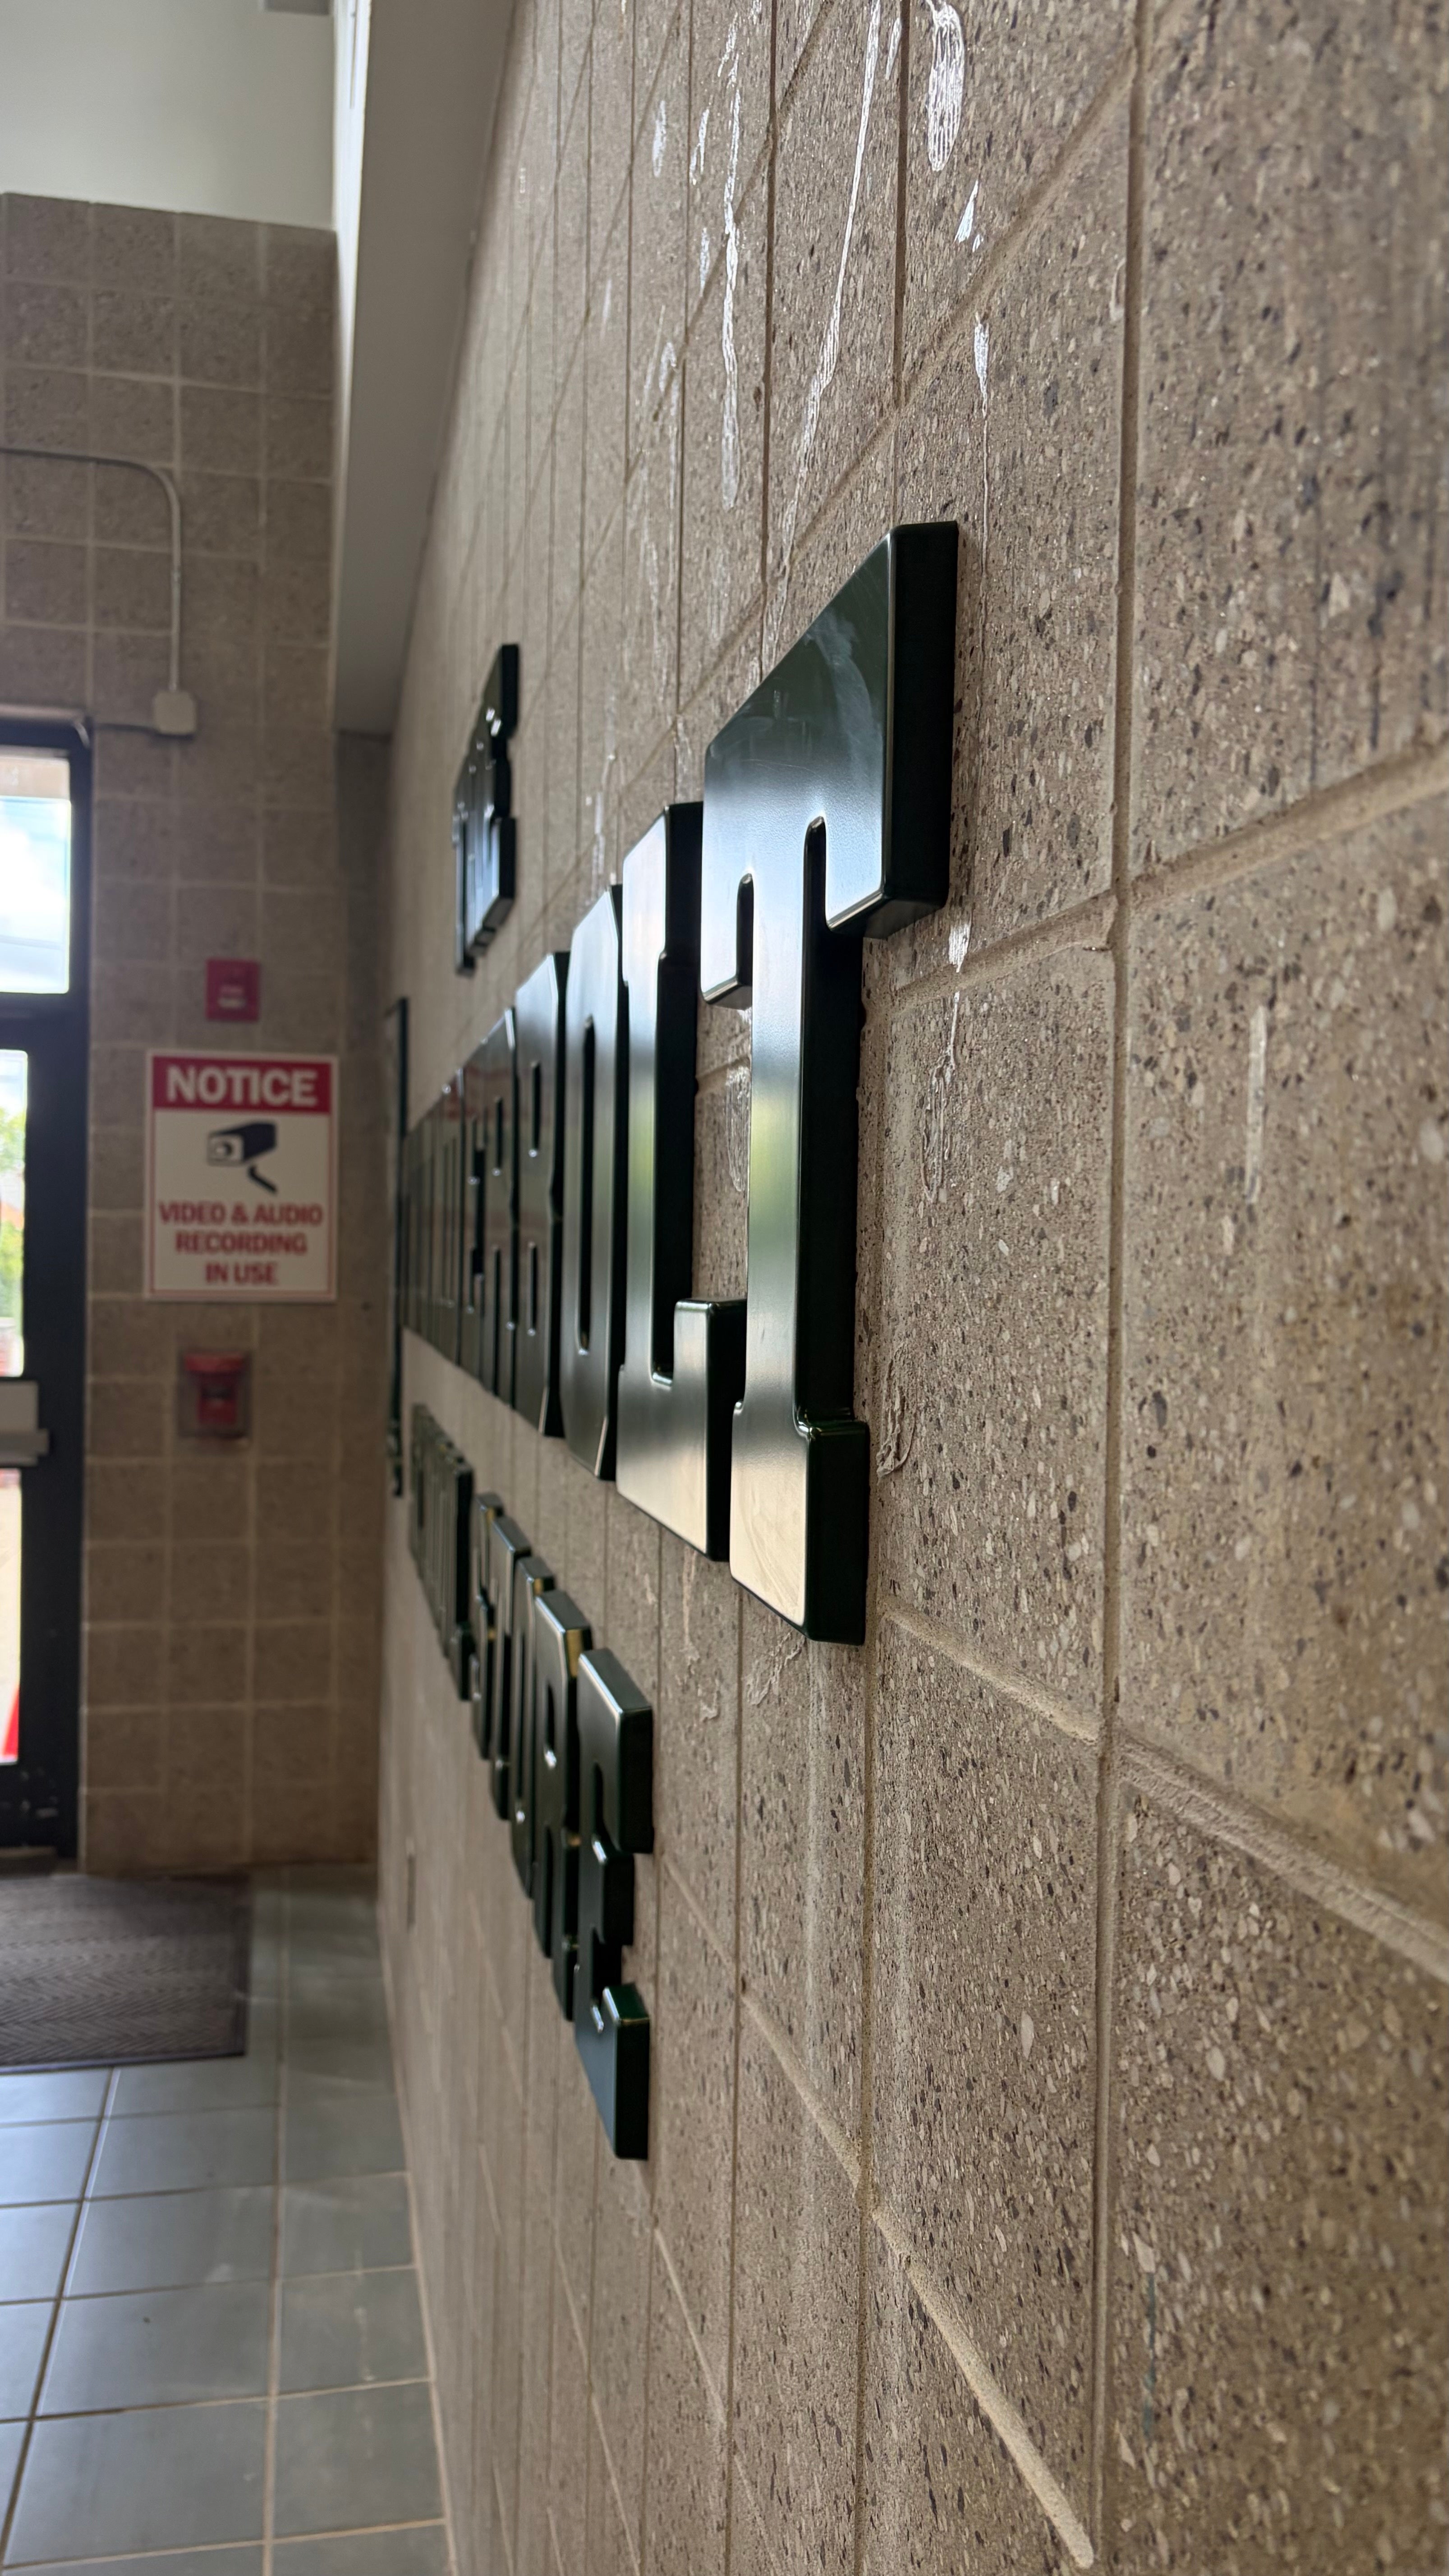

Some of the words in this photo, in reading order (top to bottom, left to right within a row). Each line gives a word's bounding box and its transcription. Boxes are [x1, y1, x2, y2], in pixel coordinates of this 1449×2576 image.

[166, 1065, 318, 1107] NOTICE
[383, 522, 958, 1645] TDERBOLT
[158, 1201, 225, 1226] VIDEO
[231, 1201, 249, 1226] &
[253, 1202, 323, 1228] AUDIO
[175, 1229, 308, 1256] RECORDING
[206, 1262, 229, 1284] IN
[234, 1262, 278, 1285] USE
[470, 1492, 654, 2160] STORE
